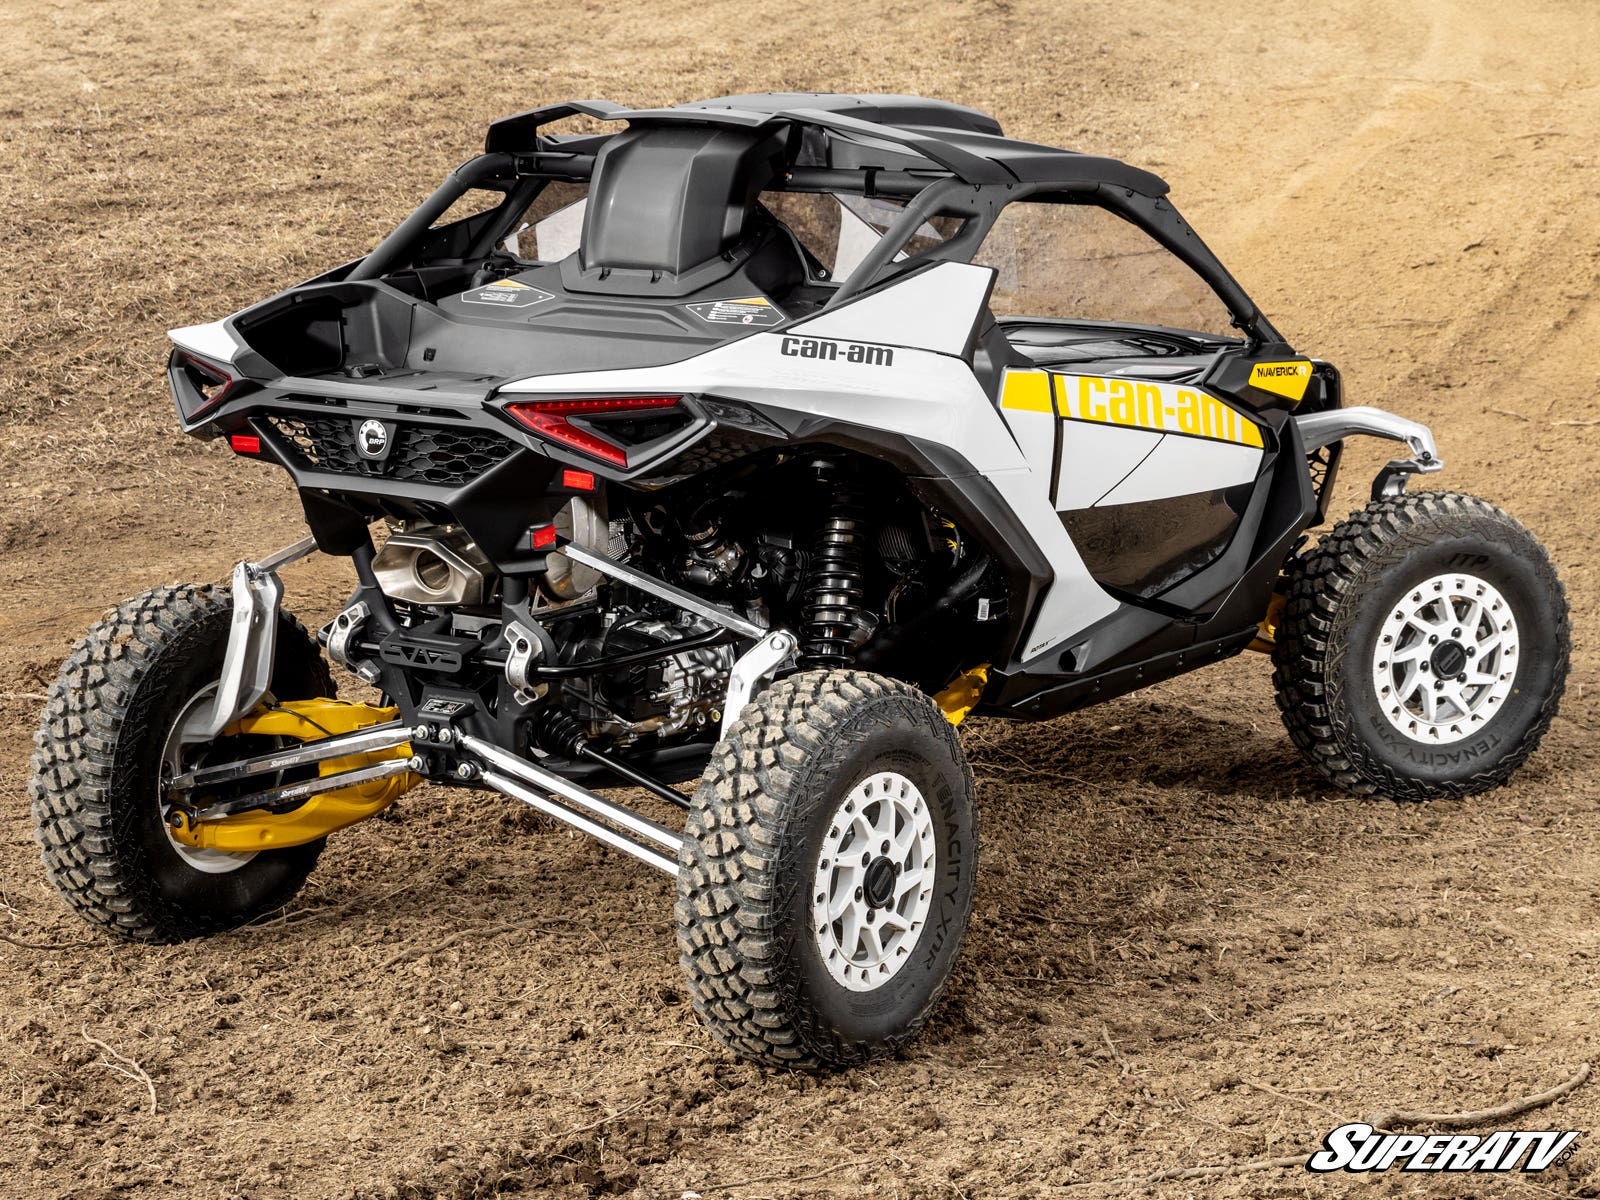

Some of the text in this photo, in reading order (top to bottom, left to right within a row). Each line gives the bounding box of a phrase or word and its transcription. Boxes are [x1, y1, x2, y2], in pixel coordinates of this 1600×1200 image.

[781, 337, 894, 367] can-am
[1256, 366, 1299, 378] MAVERICK
[1078, 376, 1237, 443] can-am
[368, 437, 386, 446] BRP
[1448, 552, 1490, 568] ITP
[1403, 733, 1502, 767] TENACITY
[932, 772, 962, 905] TENACITY
